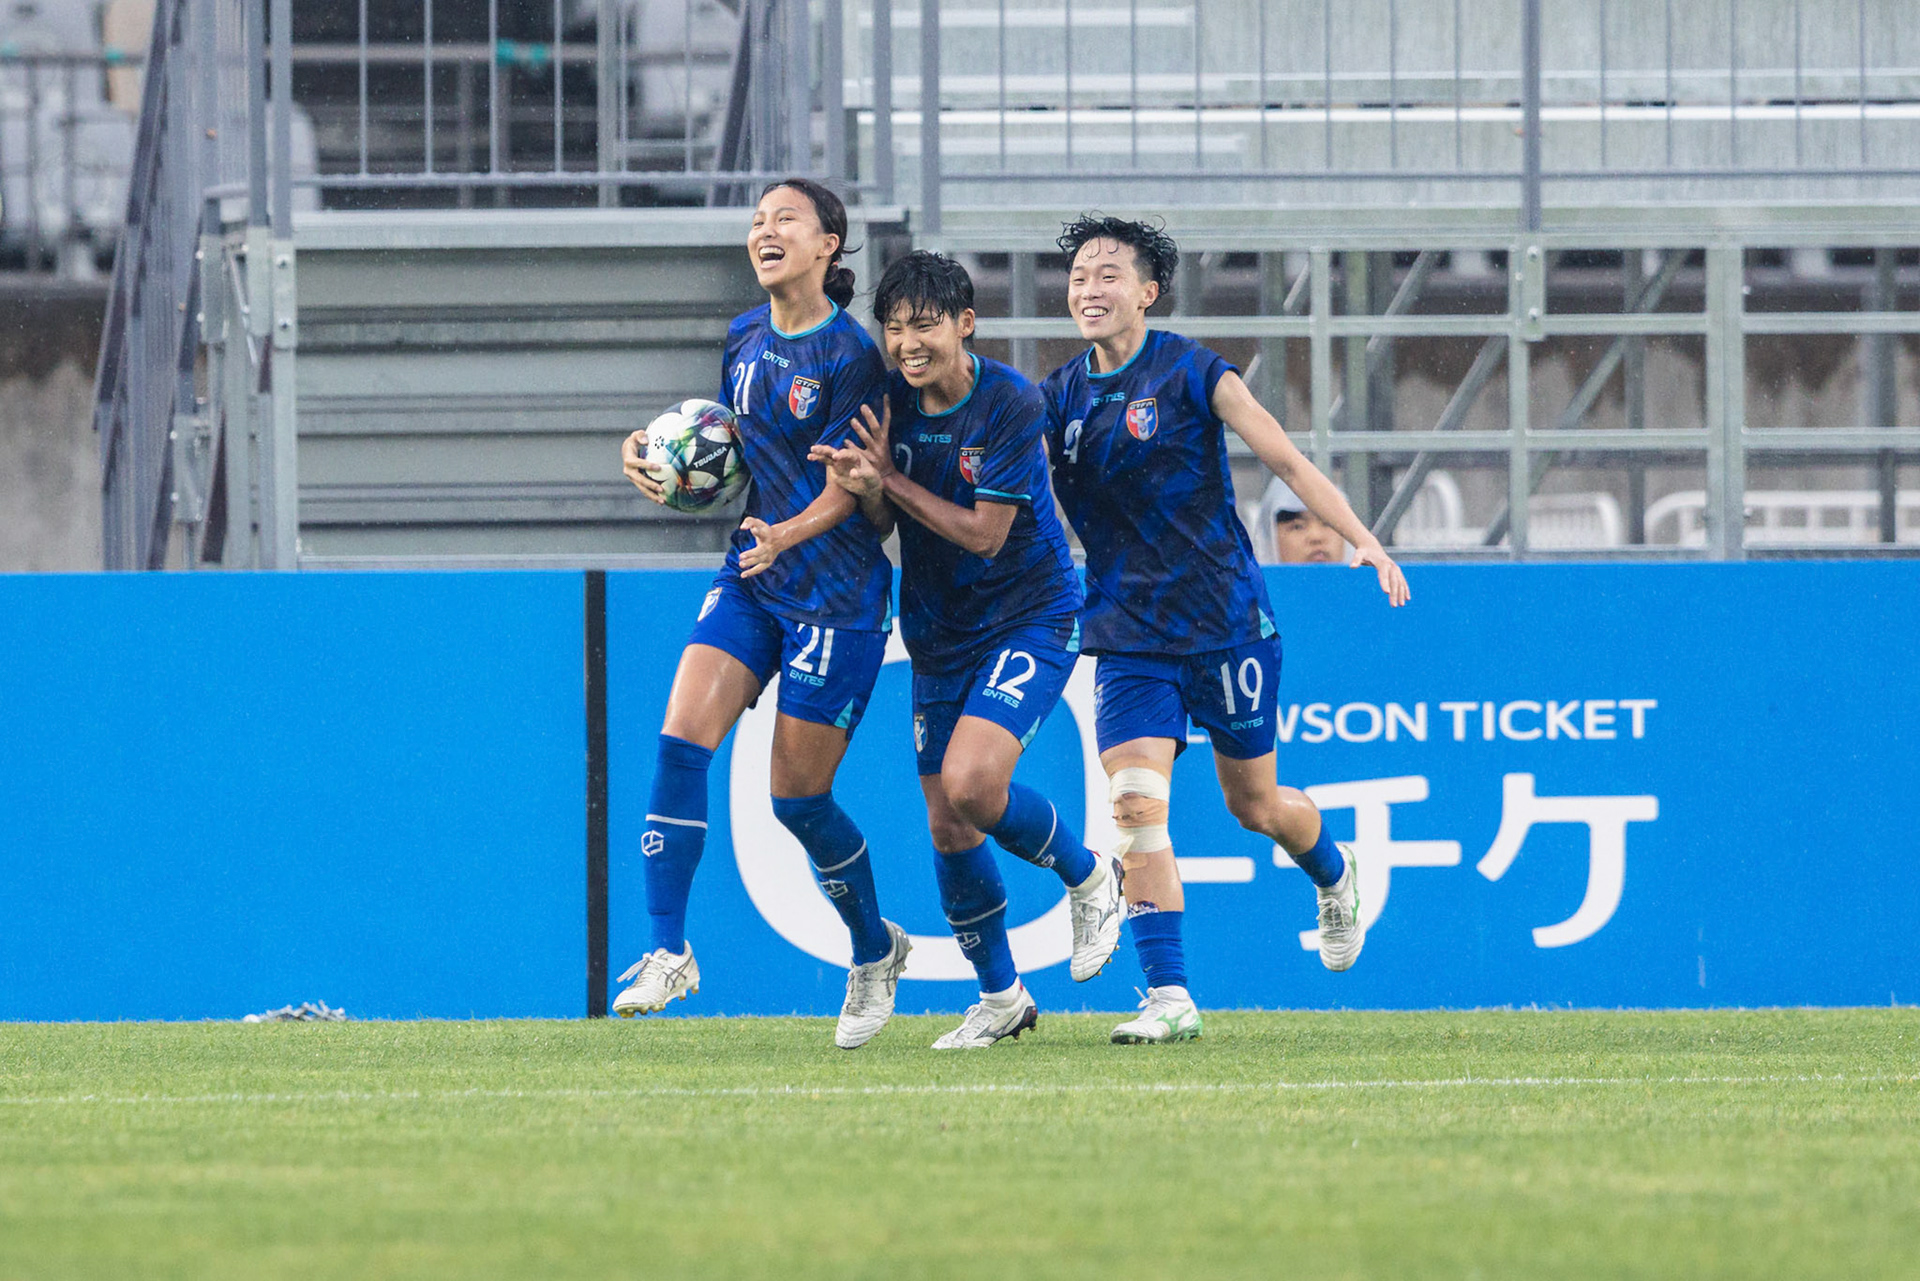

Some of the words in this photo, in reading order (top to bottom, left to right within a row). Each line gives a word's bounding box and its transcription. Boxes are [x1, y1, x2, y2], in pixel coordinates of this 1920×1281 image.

[762, 350, 791, 369] ENTES
[733, 361, 756, 416] 21
[918, 433, 952, 444] ENTES
[693, 445, 727, 469] TSUBASA
[789, 623, 835, 676] 21
[789, 669, 826, 687] ENTES
[985, 648, 1037, 701] 12
[1220, 657, 1263, 715] 19
[982, 687, 1020, 709] ENTES
[1230, 716, 1264, 731] ENTES
[1439, 698, 1658, 741] TICKET
